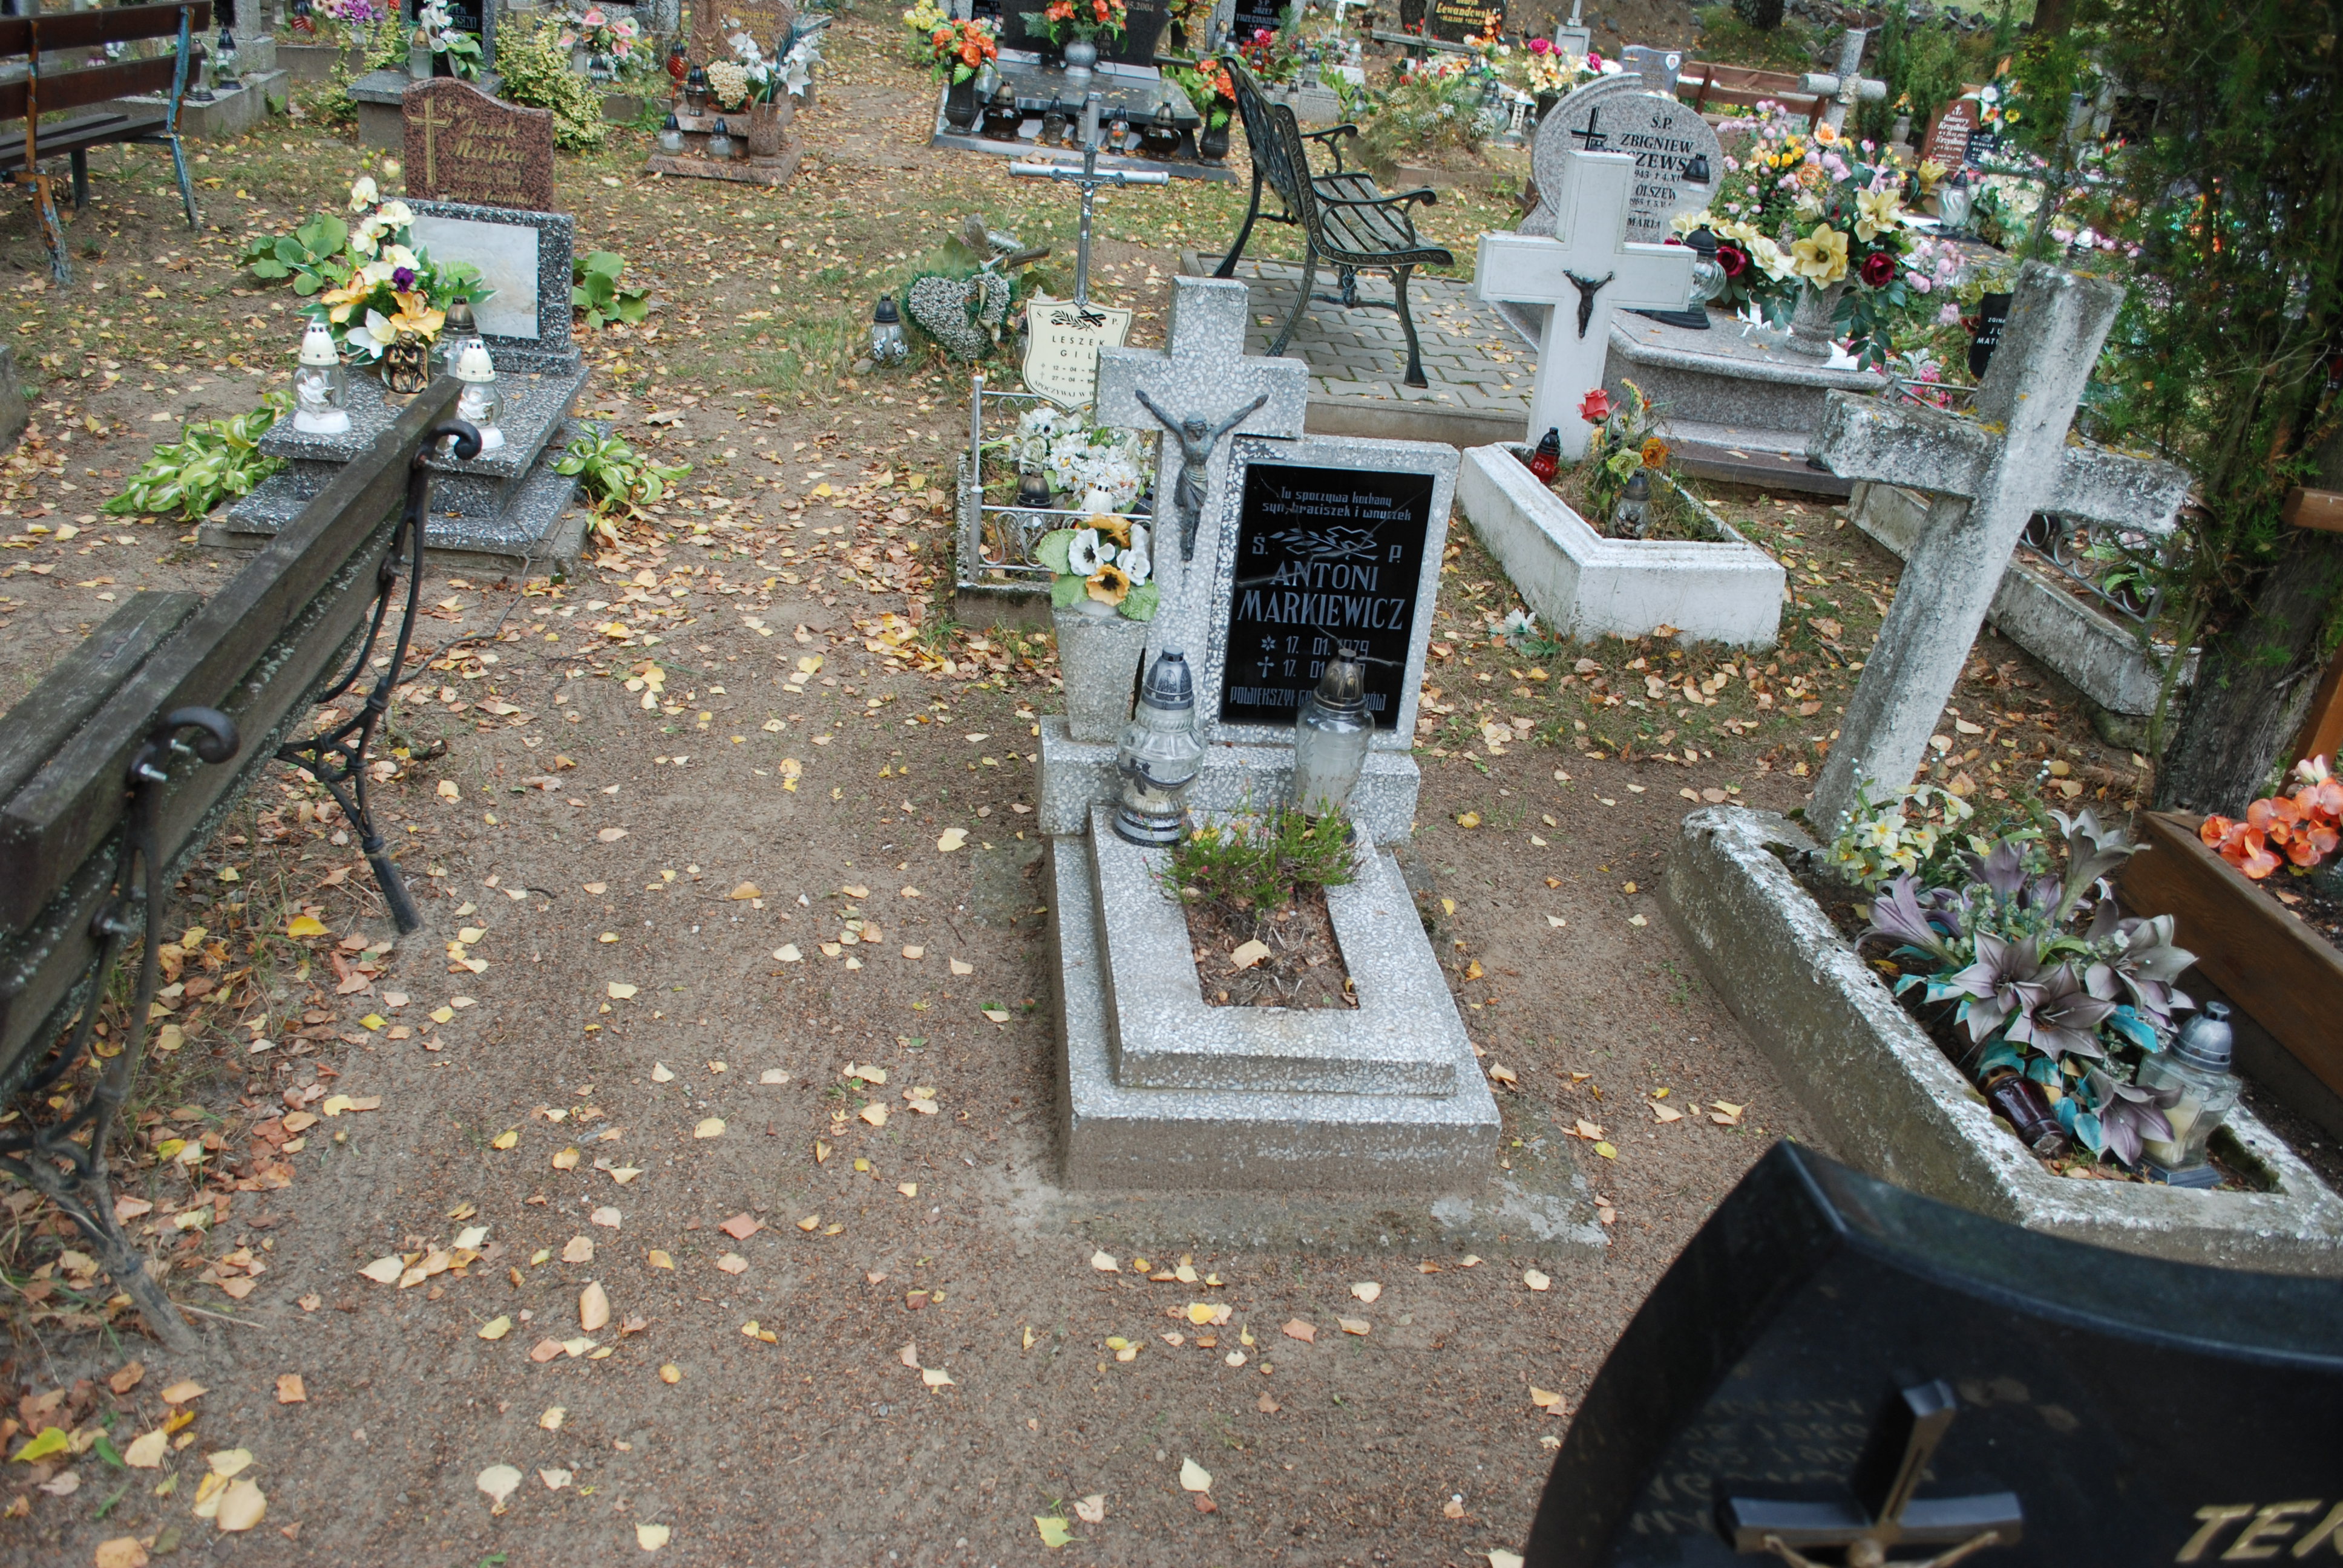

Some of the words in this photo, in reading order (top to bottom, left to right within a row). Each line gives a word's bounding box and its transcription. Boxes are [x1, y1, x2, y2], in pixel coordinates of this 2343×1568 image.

[1436, 2, 1492, 18] Lewandowsk
[1620, 132, 1695, 154] ZBIGNIEW
[1634, 169, 1650, 179] 943
[1281, 486, 1291, 500] Tu
[1296, 491, 1348, 503] spoczywa
[1352, 492, 1392, 508] kochany
[1292, 502, 1351, 517] braciszek
[1354, 506, 1359, 517] i
[1363, 508, 1412, 521] wnuczek
[1270, 560, 1380, 592] ANTONI
[1237, 589, 1406, 630] MARKIEWICZ
[1286, 636, 1299, 654] 17.
[1312, 637, 1331, 656] 01.
[1283, 659, 1296, 677] 17.
